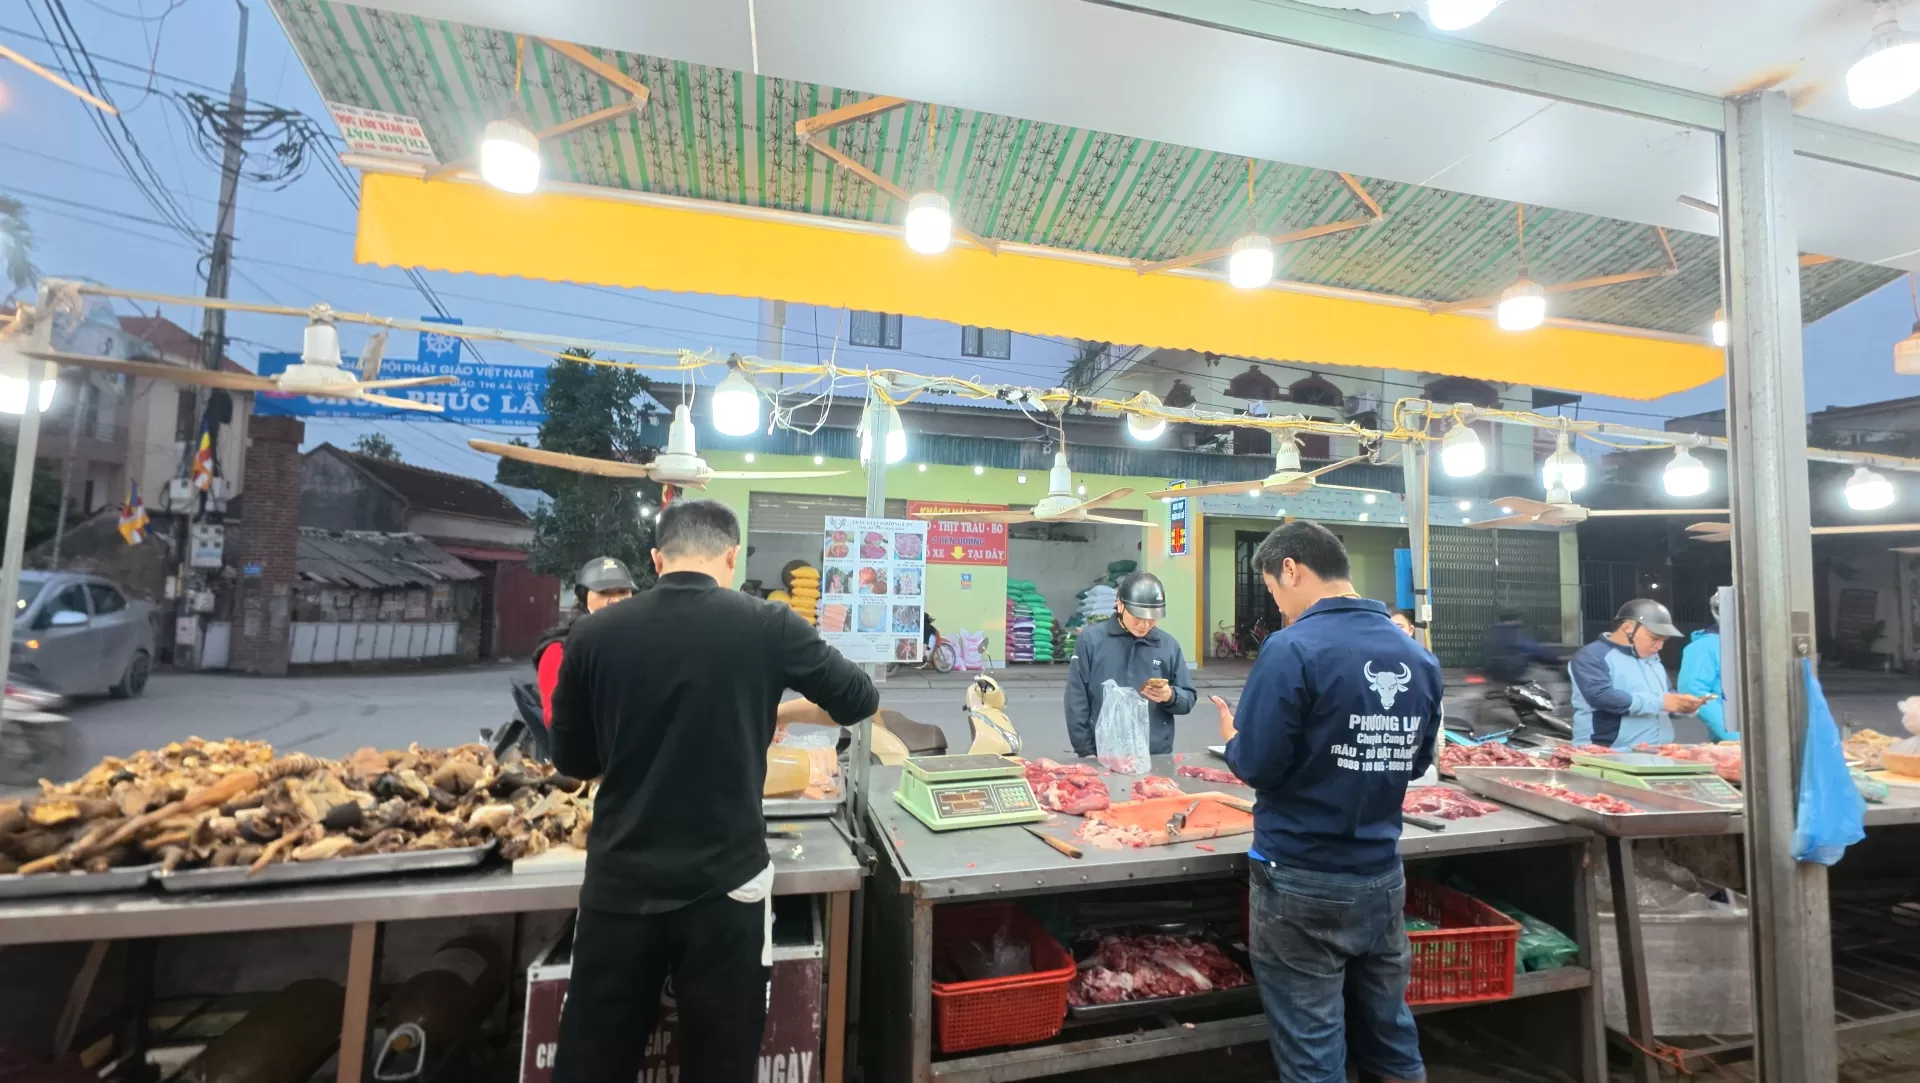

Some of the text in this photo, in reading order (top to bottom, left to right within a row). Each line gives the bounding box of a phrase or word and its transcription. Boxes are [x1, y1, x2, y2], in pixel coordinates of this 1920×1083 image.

[403, 361, 437, 375] PHẬT
[440, 362, 474, 375] GIÁO
[476, 365, 502, 379] VIỆT
[504, 369, 535, 379] NAM
[938, 521, 960, 535] THỊT
[933, 549, 945, 558] XE
[967, 549, 984, 560] TẠI
[985, 547, 1004, 560] ĐÂY
[1349, 714, 1400, 731] PHƯƠNG
[1330, 743, 1358, 757] TRÂU
[1337, 757, 1360, 771] 0988
